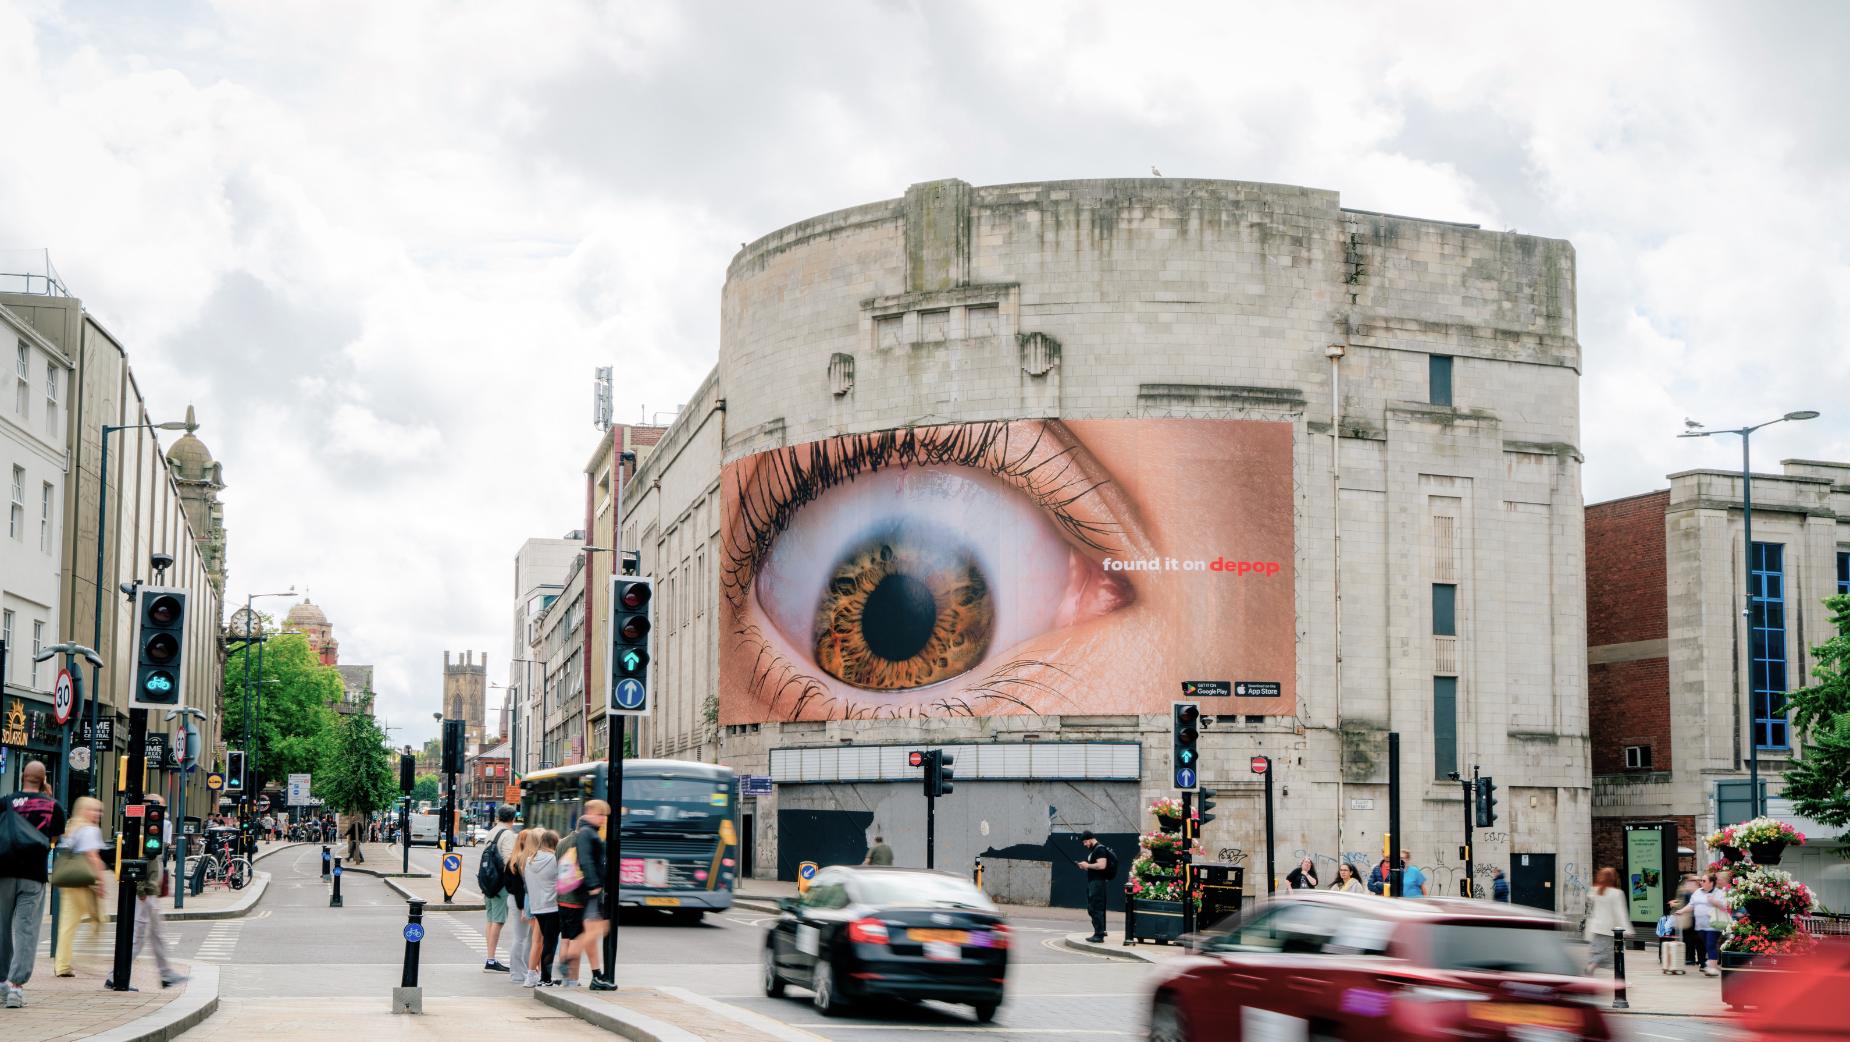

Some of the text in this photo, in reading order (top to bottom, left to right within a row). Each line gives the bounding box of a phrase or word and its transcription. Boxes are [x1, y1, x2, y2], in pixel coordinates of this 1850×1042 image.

[1103, 557, 1280, 577] found it on depop
[56, 685, 70, 708] 30
[84, 721, 110, 730] LME
[177, 736, 184, 752] 30
